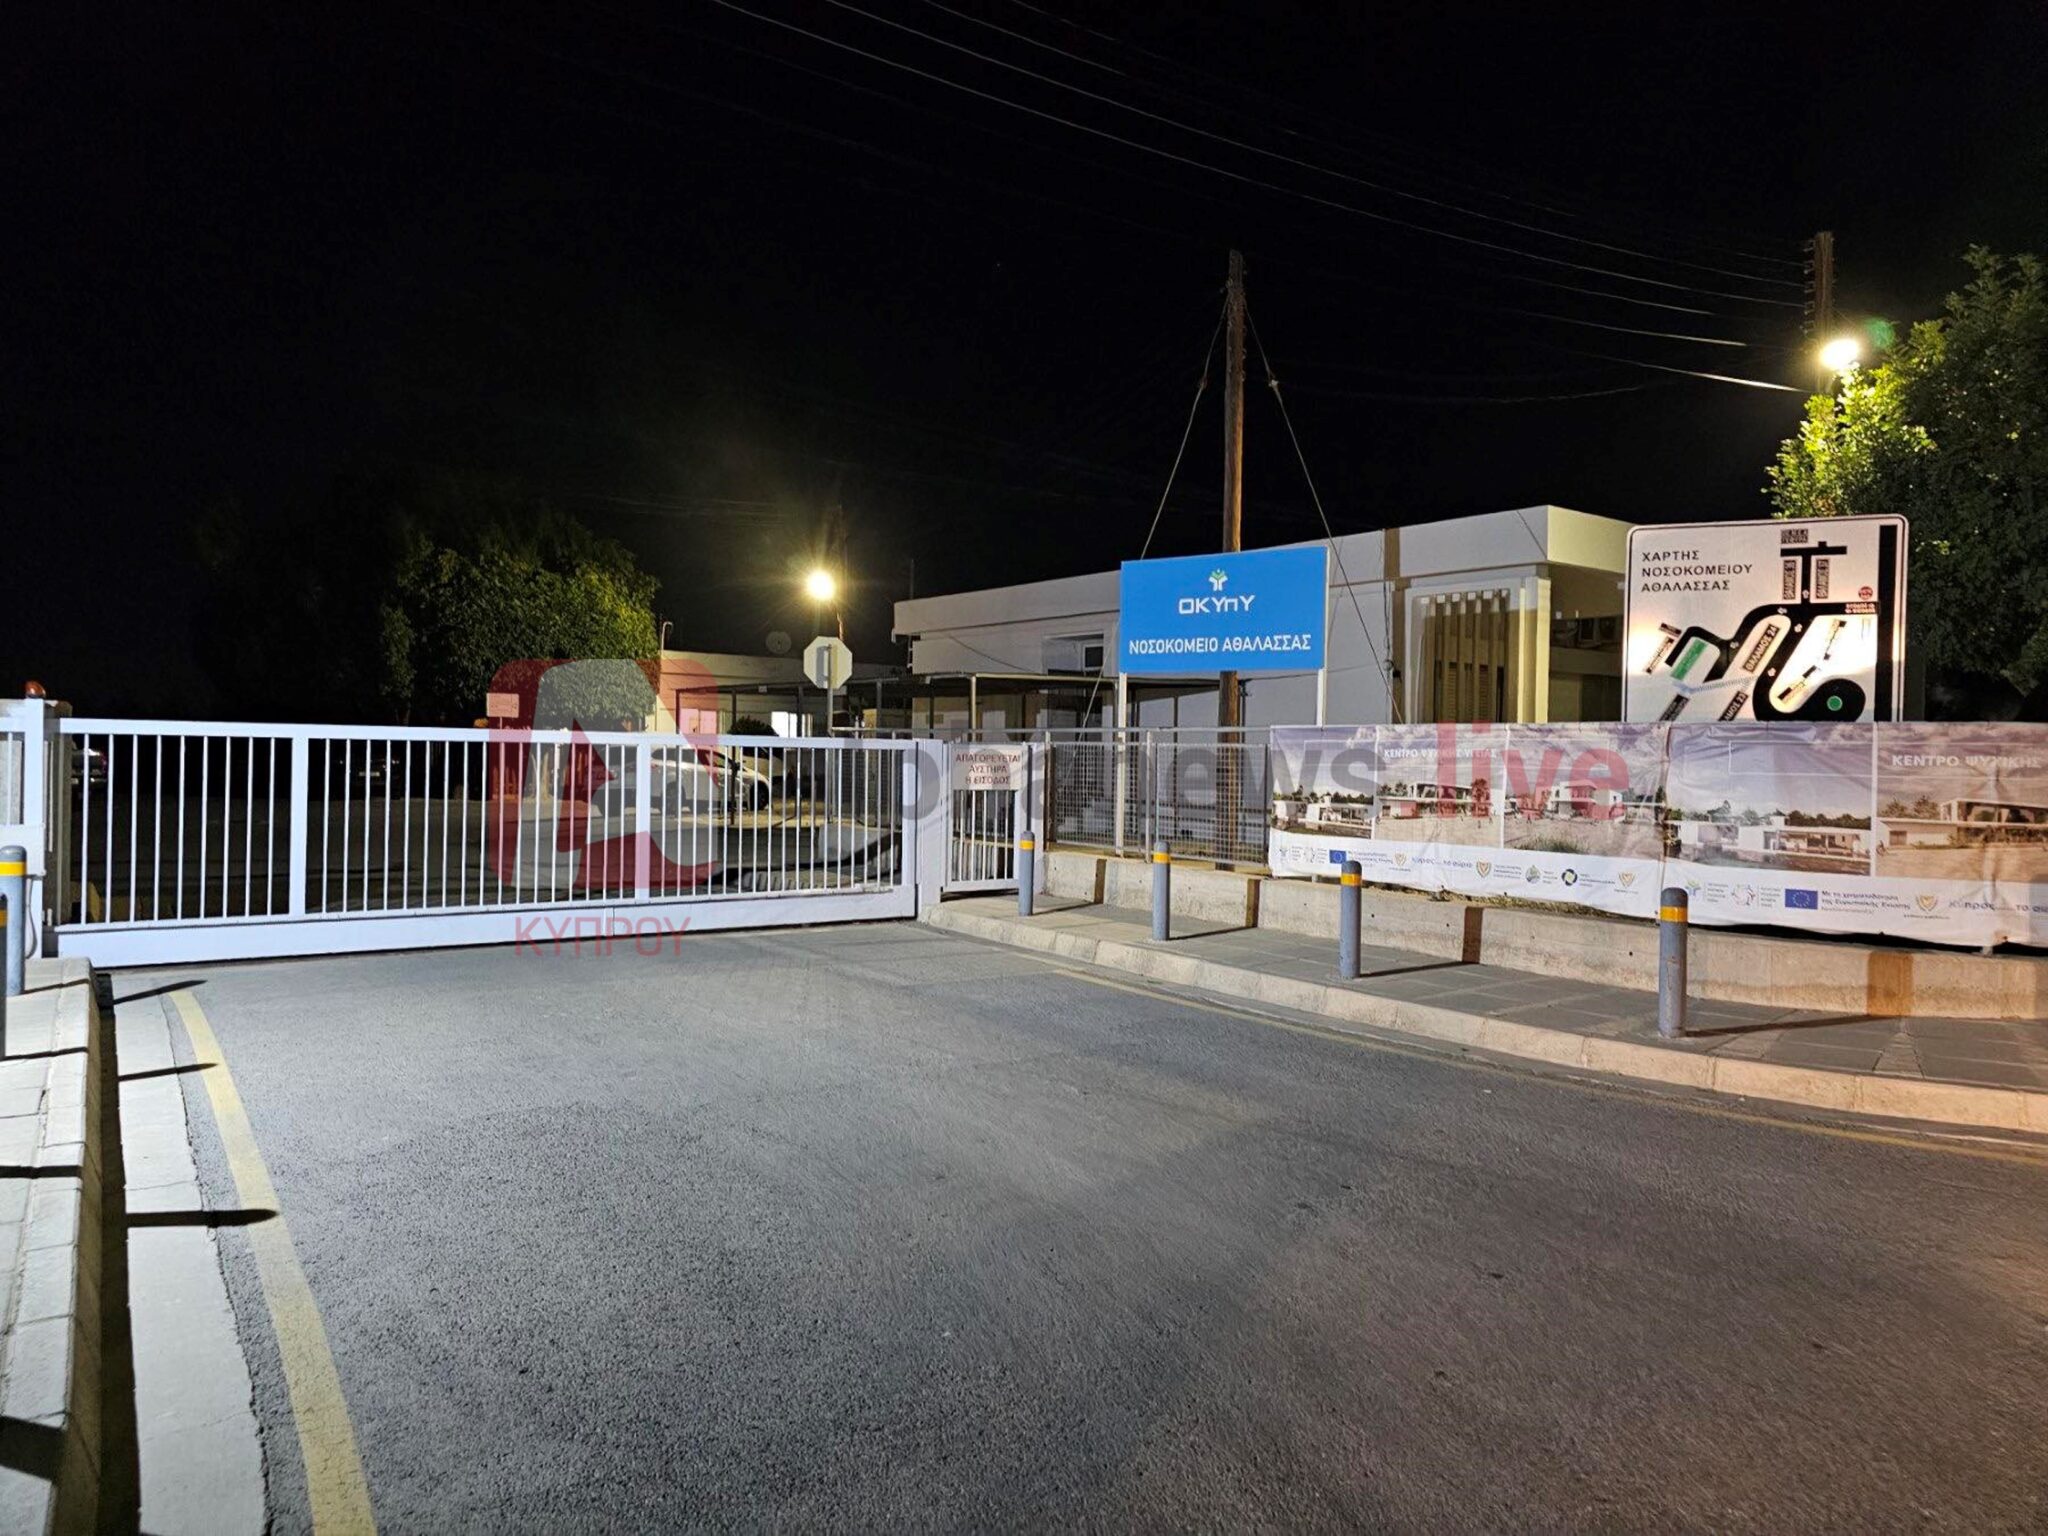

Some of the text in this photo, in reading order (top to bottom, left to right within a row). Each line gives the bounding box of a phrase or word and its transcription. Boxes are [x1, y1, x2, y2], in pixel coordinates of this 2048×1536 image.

[1642, 549, 1700, 562] ΧΑΡΤΗΣ
[1641, 563, 1753, 578] ΝΟΣΟΚΟΜΕΙΟΥ
[1641, 579, 1731, 593] ΑΘΑΛΑΣΣΑΣ
[1129, 634, 1311, 655] ΝΟΣΟΚΟΜΕΙΟ ΑΘΑΛΑΣΣΑΣ
[955, 753, 1021, 763] ΑΠΑΓΟΡΕΥΕΤΑΙ
[1891, 753, 2042, 770] ΚΕΝΤΡΟ ΨΥΧΙΚΗΣ
[969, 765, 1007, 773] ΑΥΣΤΗΡΑ
[973, 775, 1011, 785] ΕΙΣΟΔΟΣ
